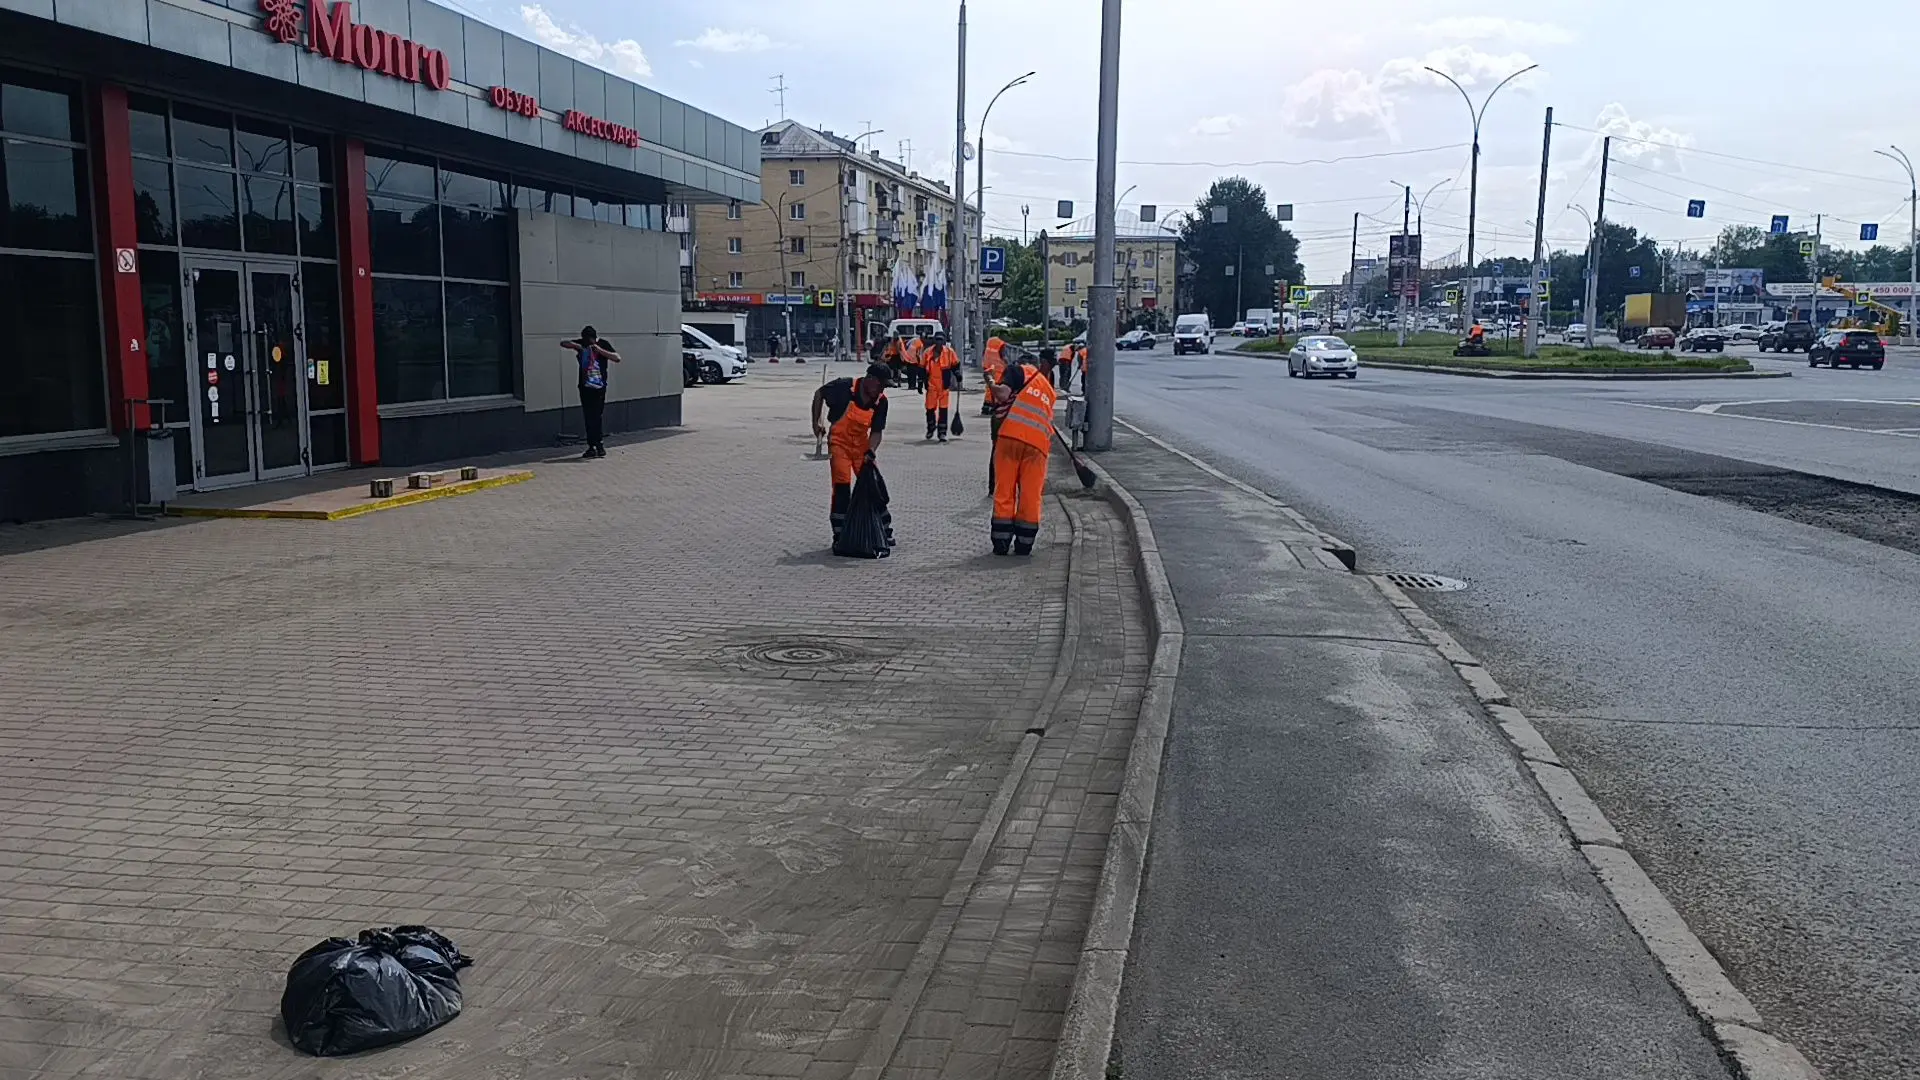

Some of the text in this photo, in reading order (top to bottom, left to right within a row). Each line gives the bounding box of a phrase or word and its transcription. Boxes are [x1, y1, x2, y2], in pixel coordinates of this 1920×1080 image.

[305, 0, 451, 90] Monro
[490, 87, 640, 148] ОБУВЬ АКСЕССУАРЫ
[985, 249, 1000, 269] P
